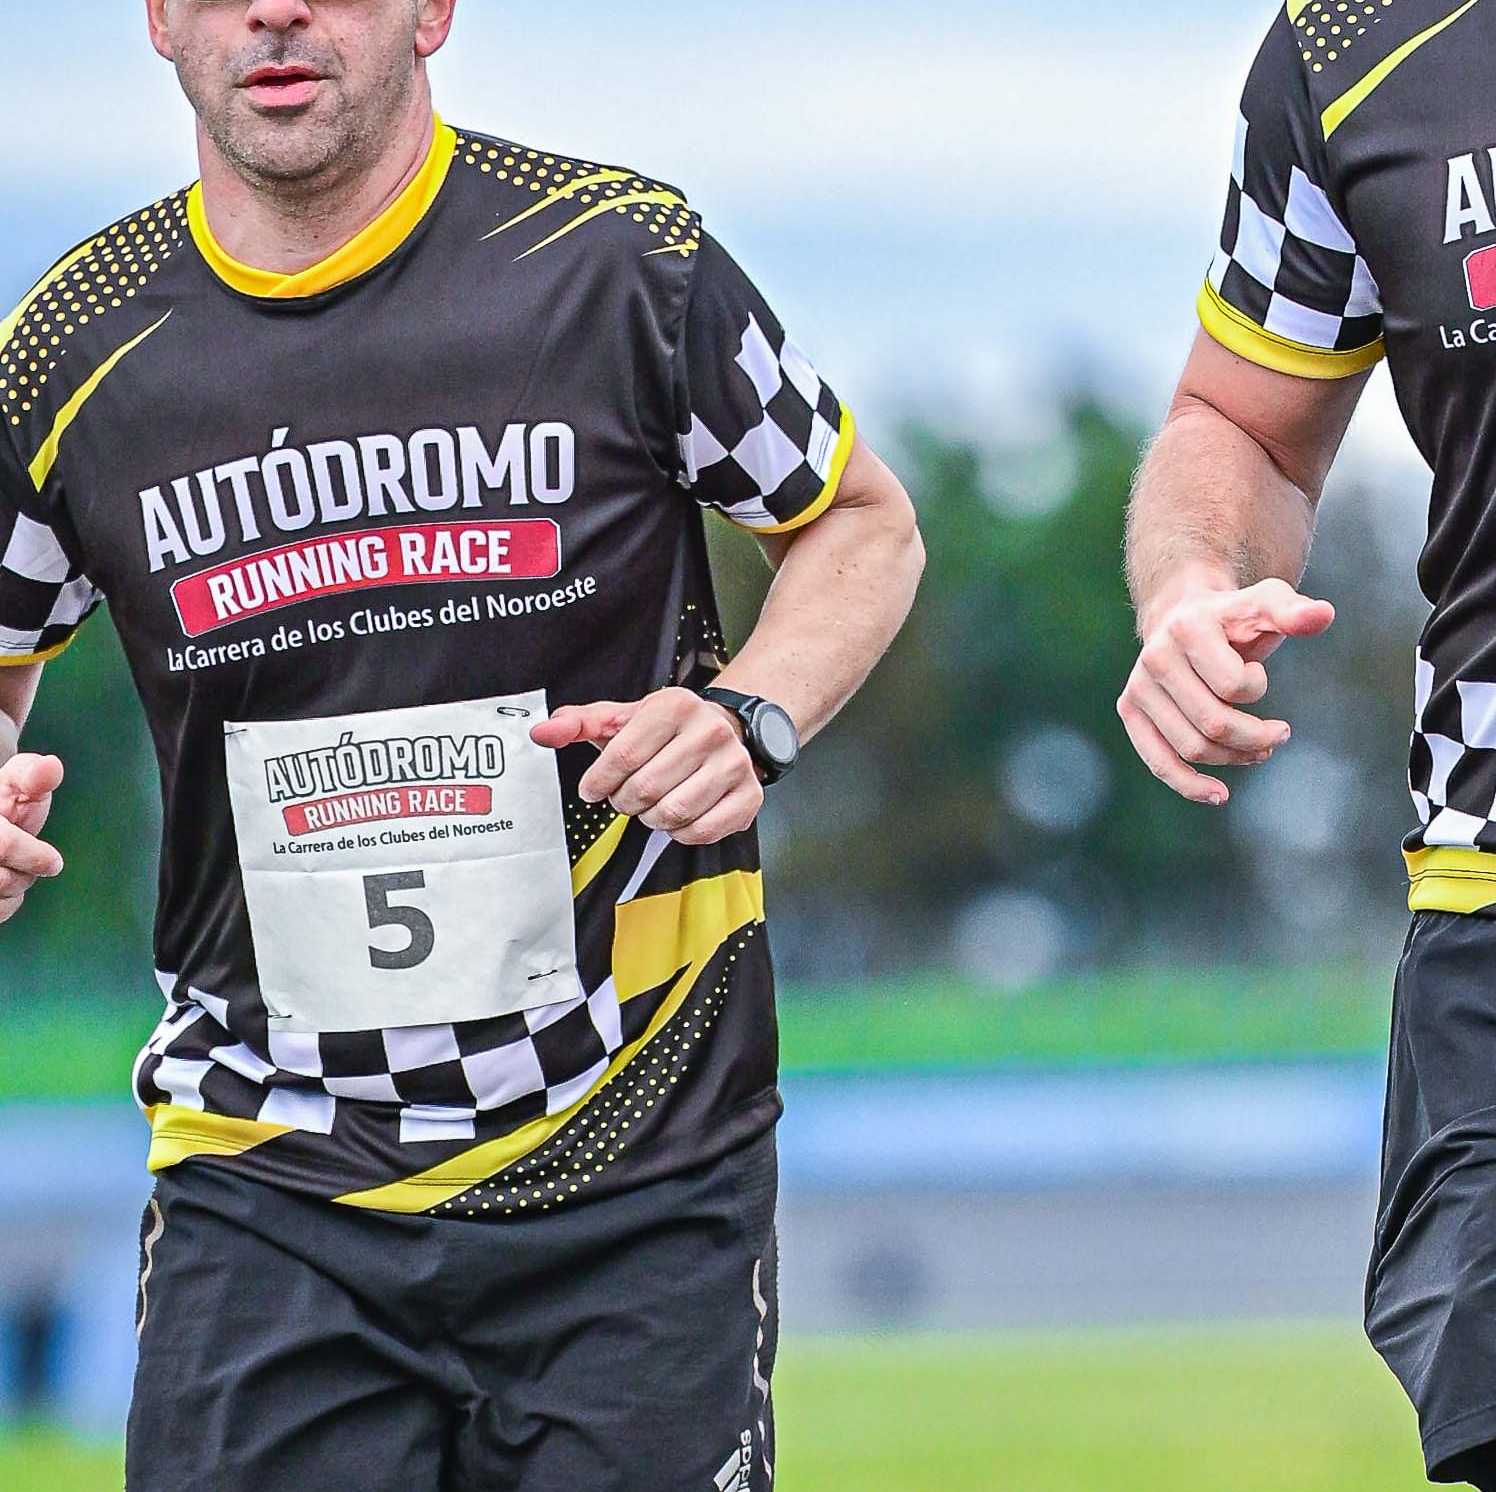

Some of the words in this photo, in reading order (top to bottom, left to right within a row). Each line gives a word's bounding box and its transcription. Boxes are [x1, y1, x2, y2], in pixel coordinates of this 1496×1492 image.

[1439, 324, 1466, 350] La
[139, 421, 575, 573] AUTÓDROMO
[206, 536, 389, 620] RUNNING
[398, 529, 512, 576] RACE
[185, 639, 265, 670] Carrera
[271, 626, 303, 650] de
[309, 620, 345, 644] los
[350, 608, 434, 636] Clubes
[440, 599, 480, 624] del
[486, 575, 597, 619] Noroeste
[264, 732, 505, 803] AUTÓDROMO
[273, 842, 286, 855] La
[287, 839, 335, 854] Carrera
[337, 835, 354, 850] de
[356, 832, 377, 848] los
[380, 828, 426, 844] Clubes
[428, 825, 450, 840] del
[452, 818, 514, 836] Noroeste
[304, 789, 401, 830] RUNNING
[408, 789, 467, 813] RACE
[362, 869, 435, 970] 5
